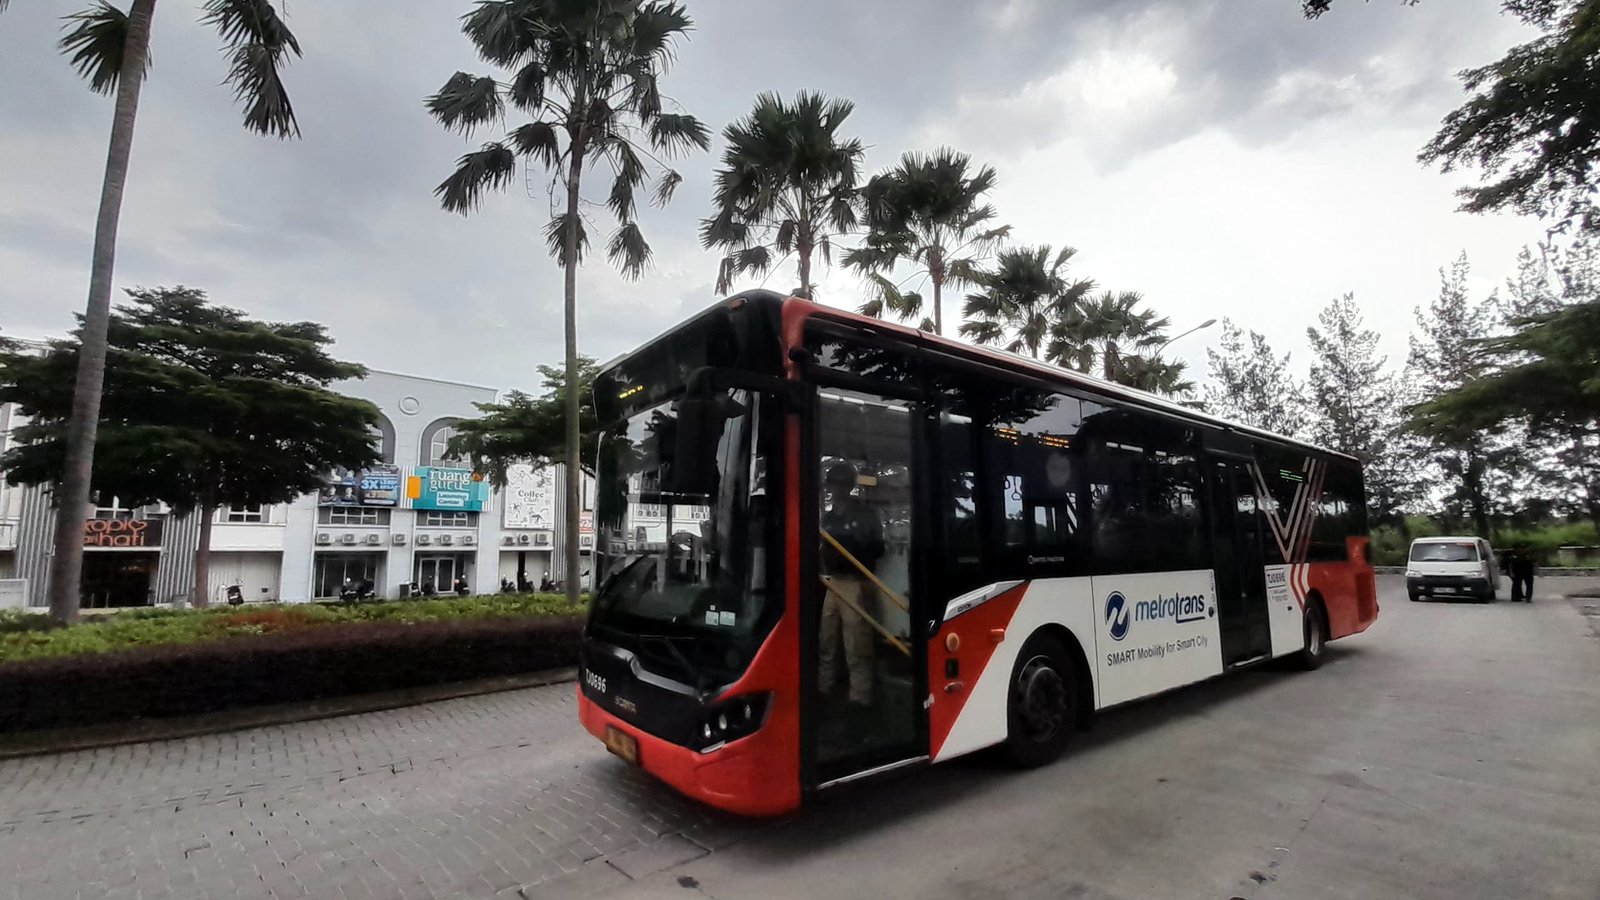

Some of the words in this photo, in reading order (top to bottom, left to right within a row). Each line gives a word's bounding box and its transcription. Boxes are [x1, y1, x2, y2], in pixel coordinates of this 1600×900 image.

[429, 470, 471, 485] ruang
[429, 479, 470, 492] guru
[100, 529, 144, 546] hati
[1135, 592, 1206, 624] metrotrans
[1107, 649, 1136, 667] SMART
[1137, 645, 1166, 659] Mobility
[1166, 641, 1176, 653] for
[1176, 638, 1196, 651] Smart
[1196, 635, 1208, 648] City
